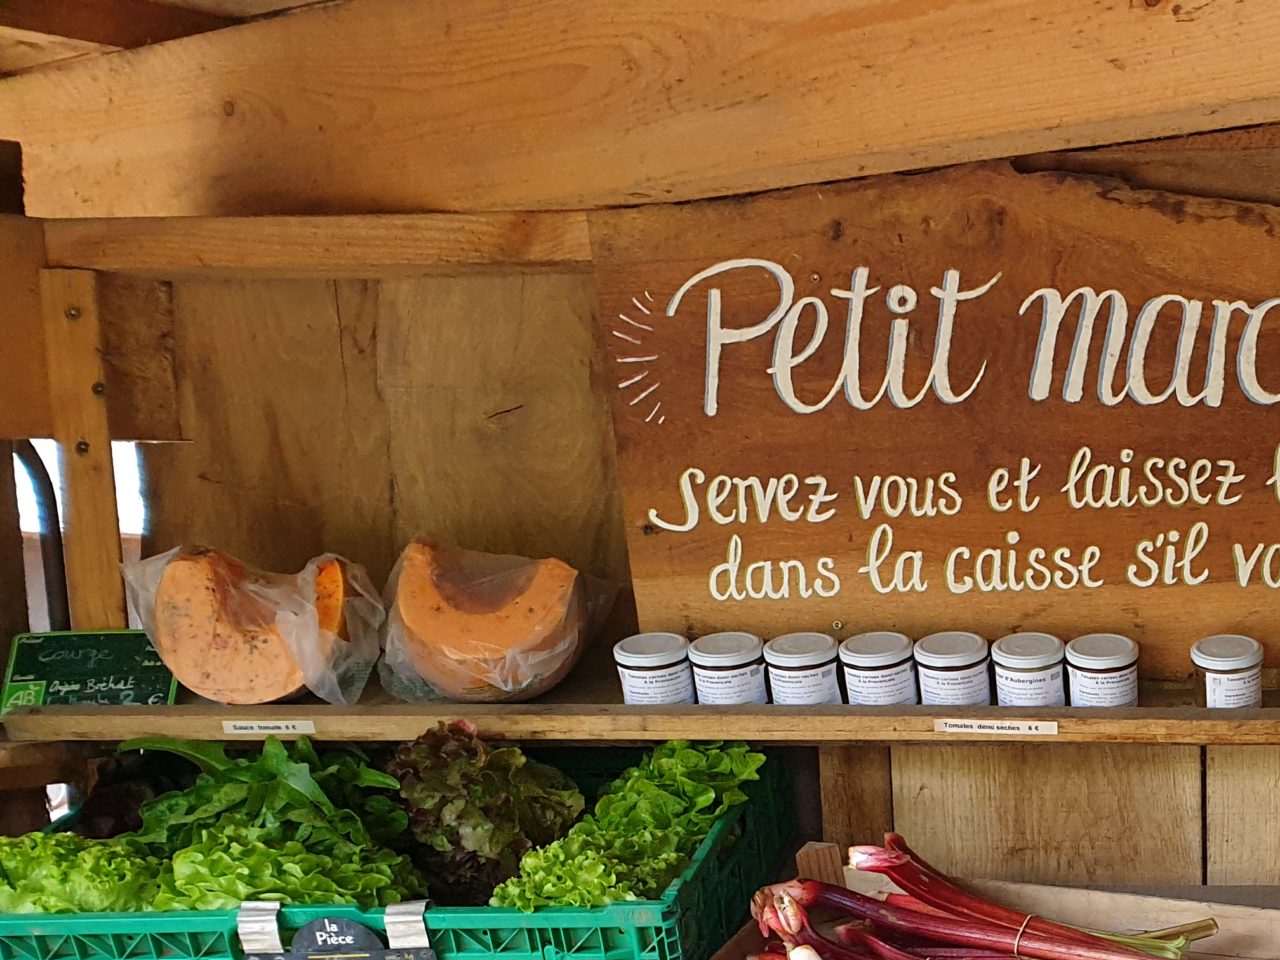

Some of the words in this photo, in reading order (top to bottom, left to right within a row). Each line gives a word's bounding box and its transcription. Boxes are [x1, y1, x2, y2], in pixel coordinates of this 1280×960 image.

[665, 258, 1002, 416] Petit
[648, 467, 838, 532] Servez
[854, 471, 963, 520] vous
[987, 457, 1041, 512] et
[1061, 446, 1245, 509] laissez
[708, 534, 841, 601] dans
[858, 523, 928, 593] la
[943, 530, 1104, 594] caisse
[1127, 521, 1210, 588] s'il
[943, 722, 974, 730] Tomates
[316, 931, 354, 946] Pièce
[324, 919, 338, 932] la
